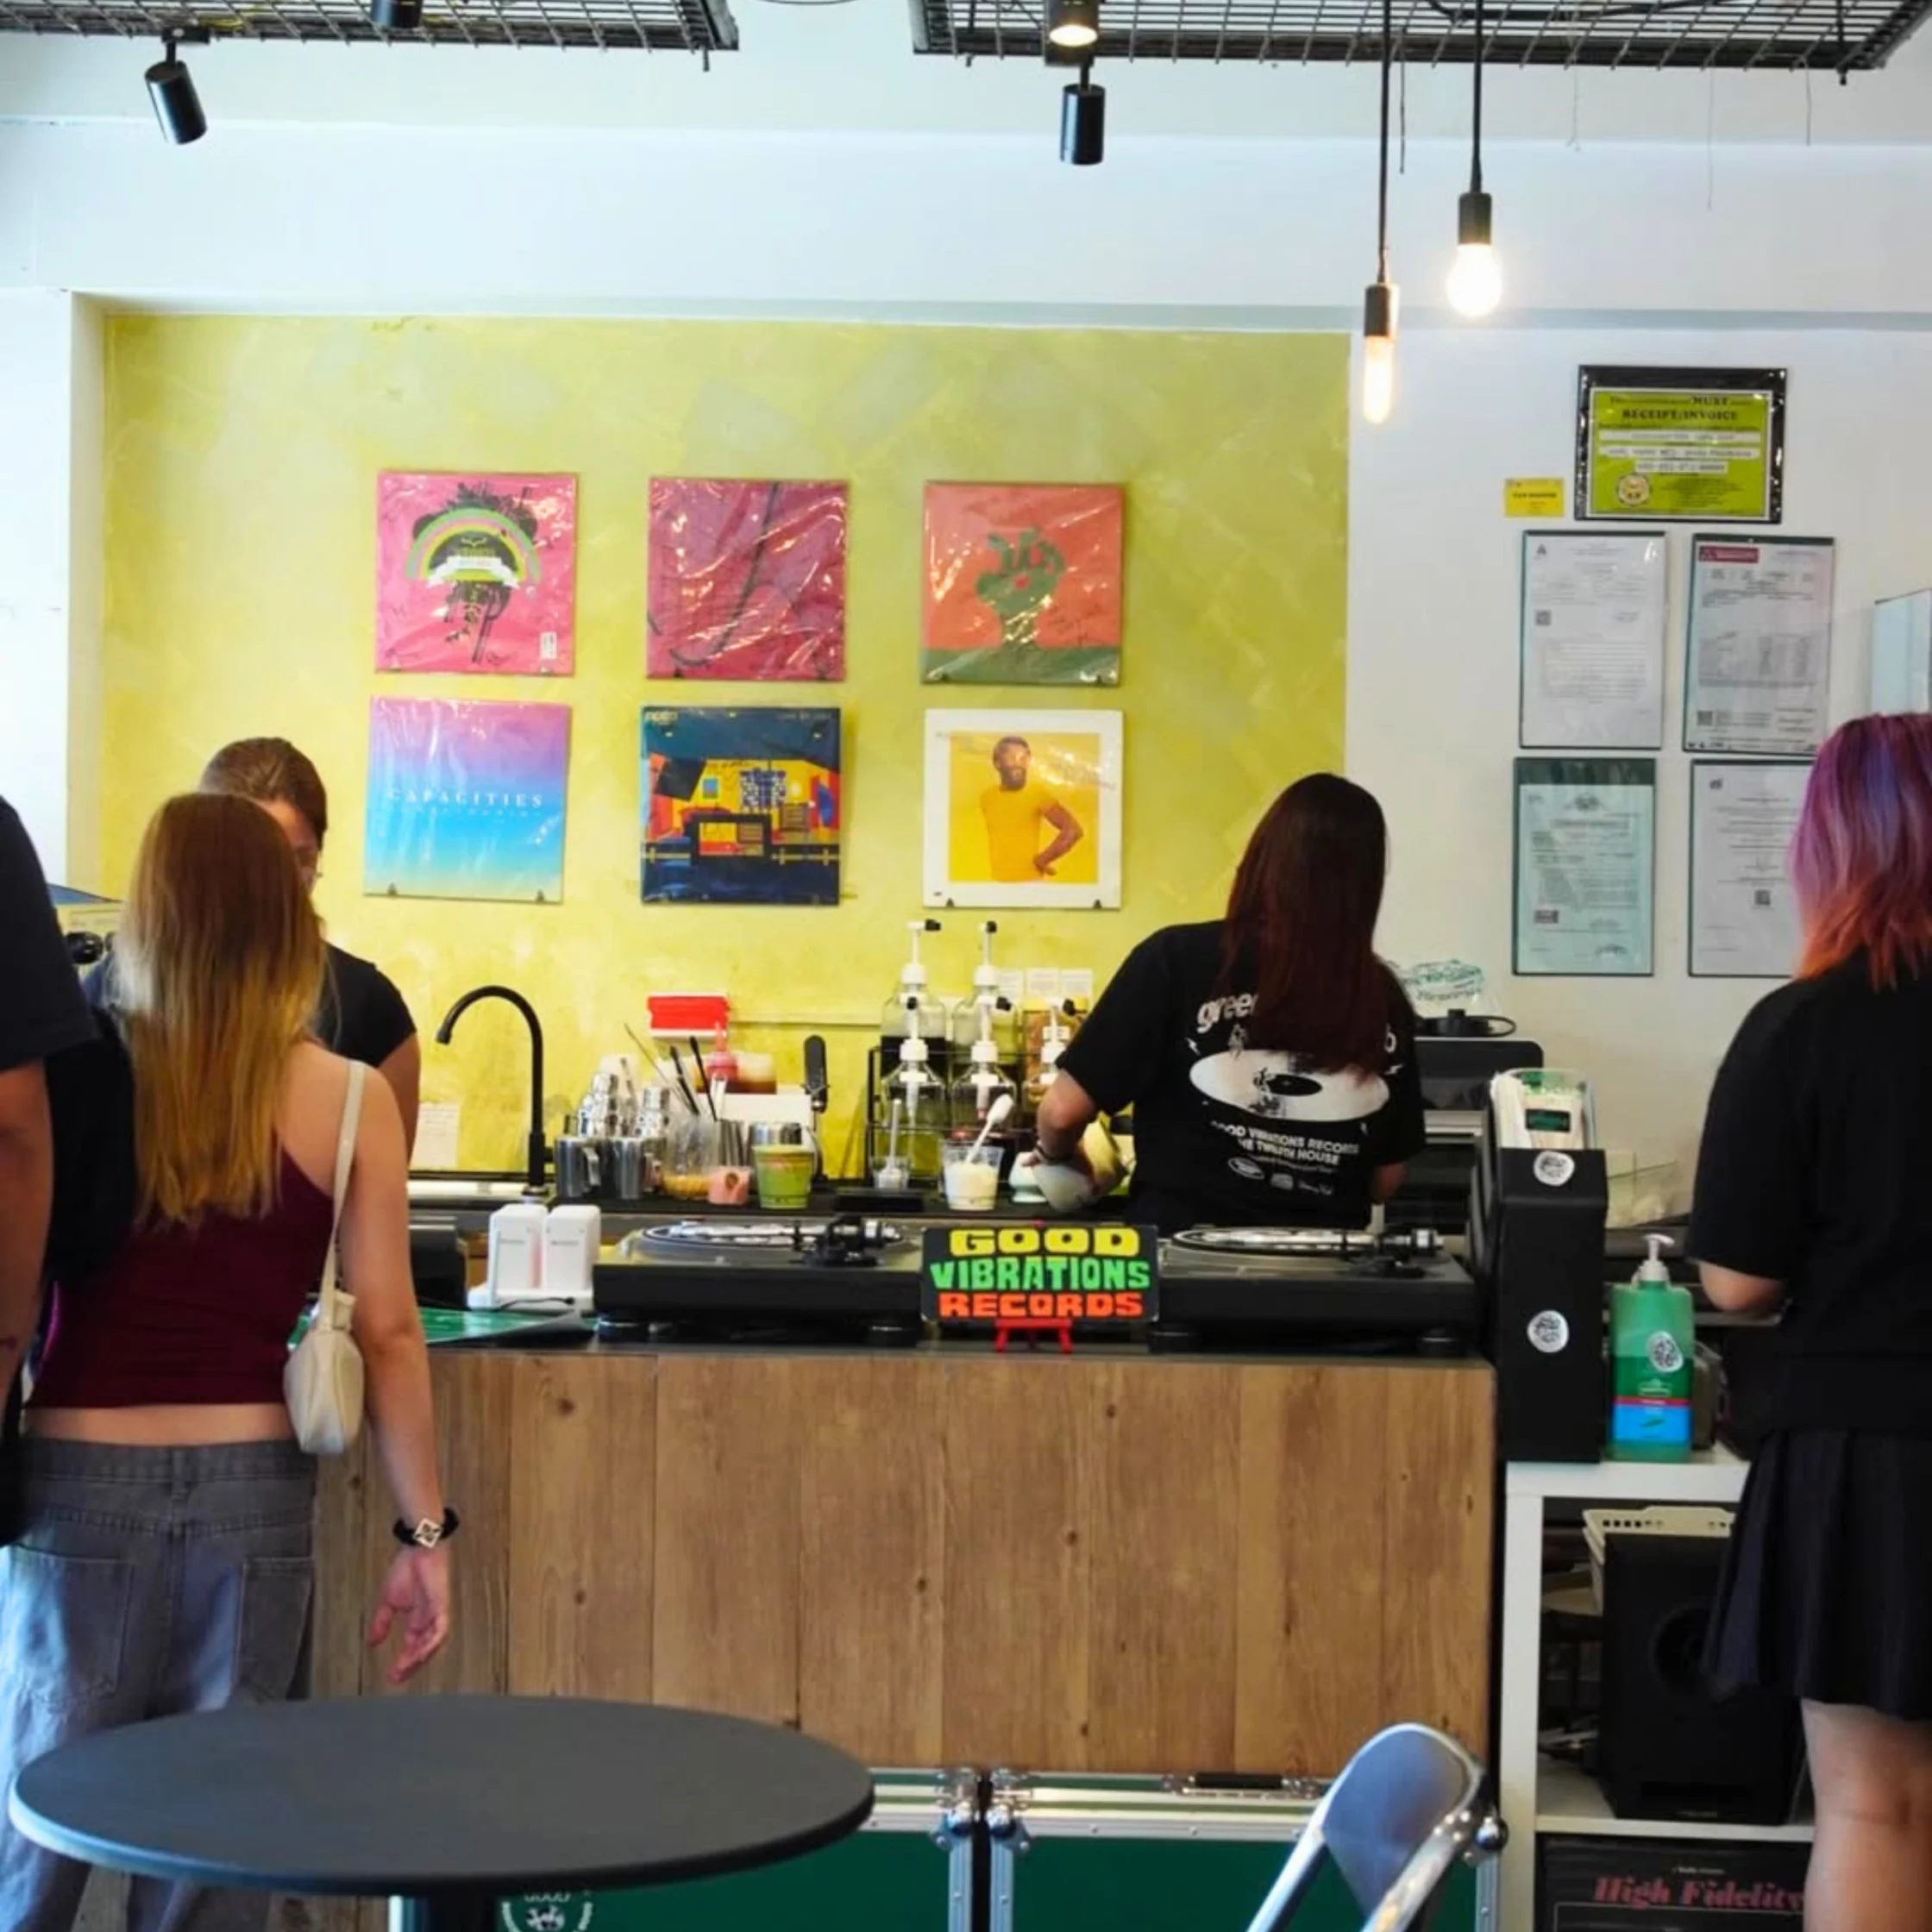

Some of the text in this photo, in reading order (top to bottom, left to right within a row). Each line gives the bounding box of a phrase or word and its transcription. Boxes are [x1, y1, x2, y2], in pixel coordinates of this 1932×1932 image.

[387, 787, 543, 808] CAPACITIES
[1297, 1148, 1339, 1165] HOUSE
[950, 1227, 1140, 1258] GOOD
[930, 1255, 1151, 1290] VIBRATIONS
[938, 1292, 1144, 1318] RECORDS
[1596, 1876, 1671, 1910] High
